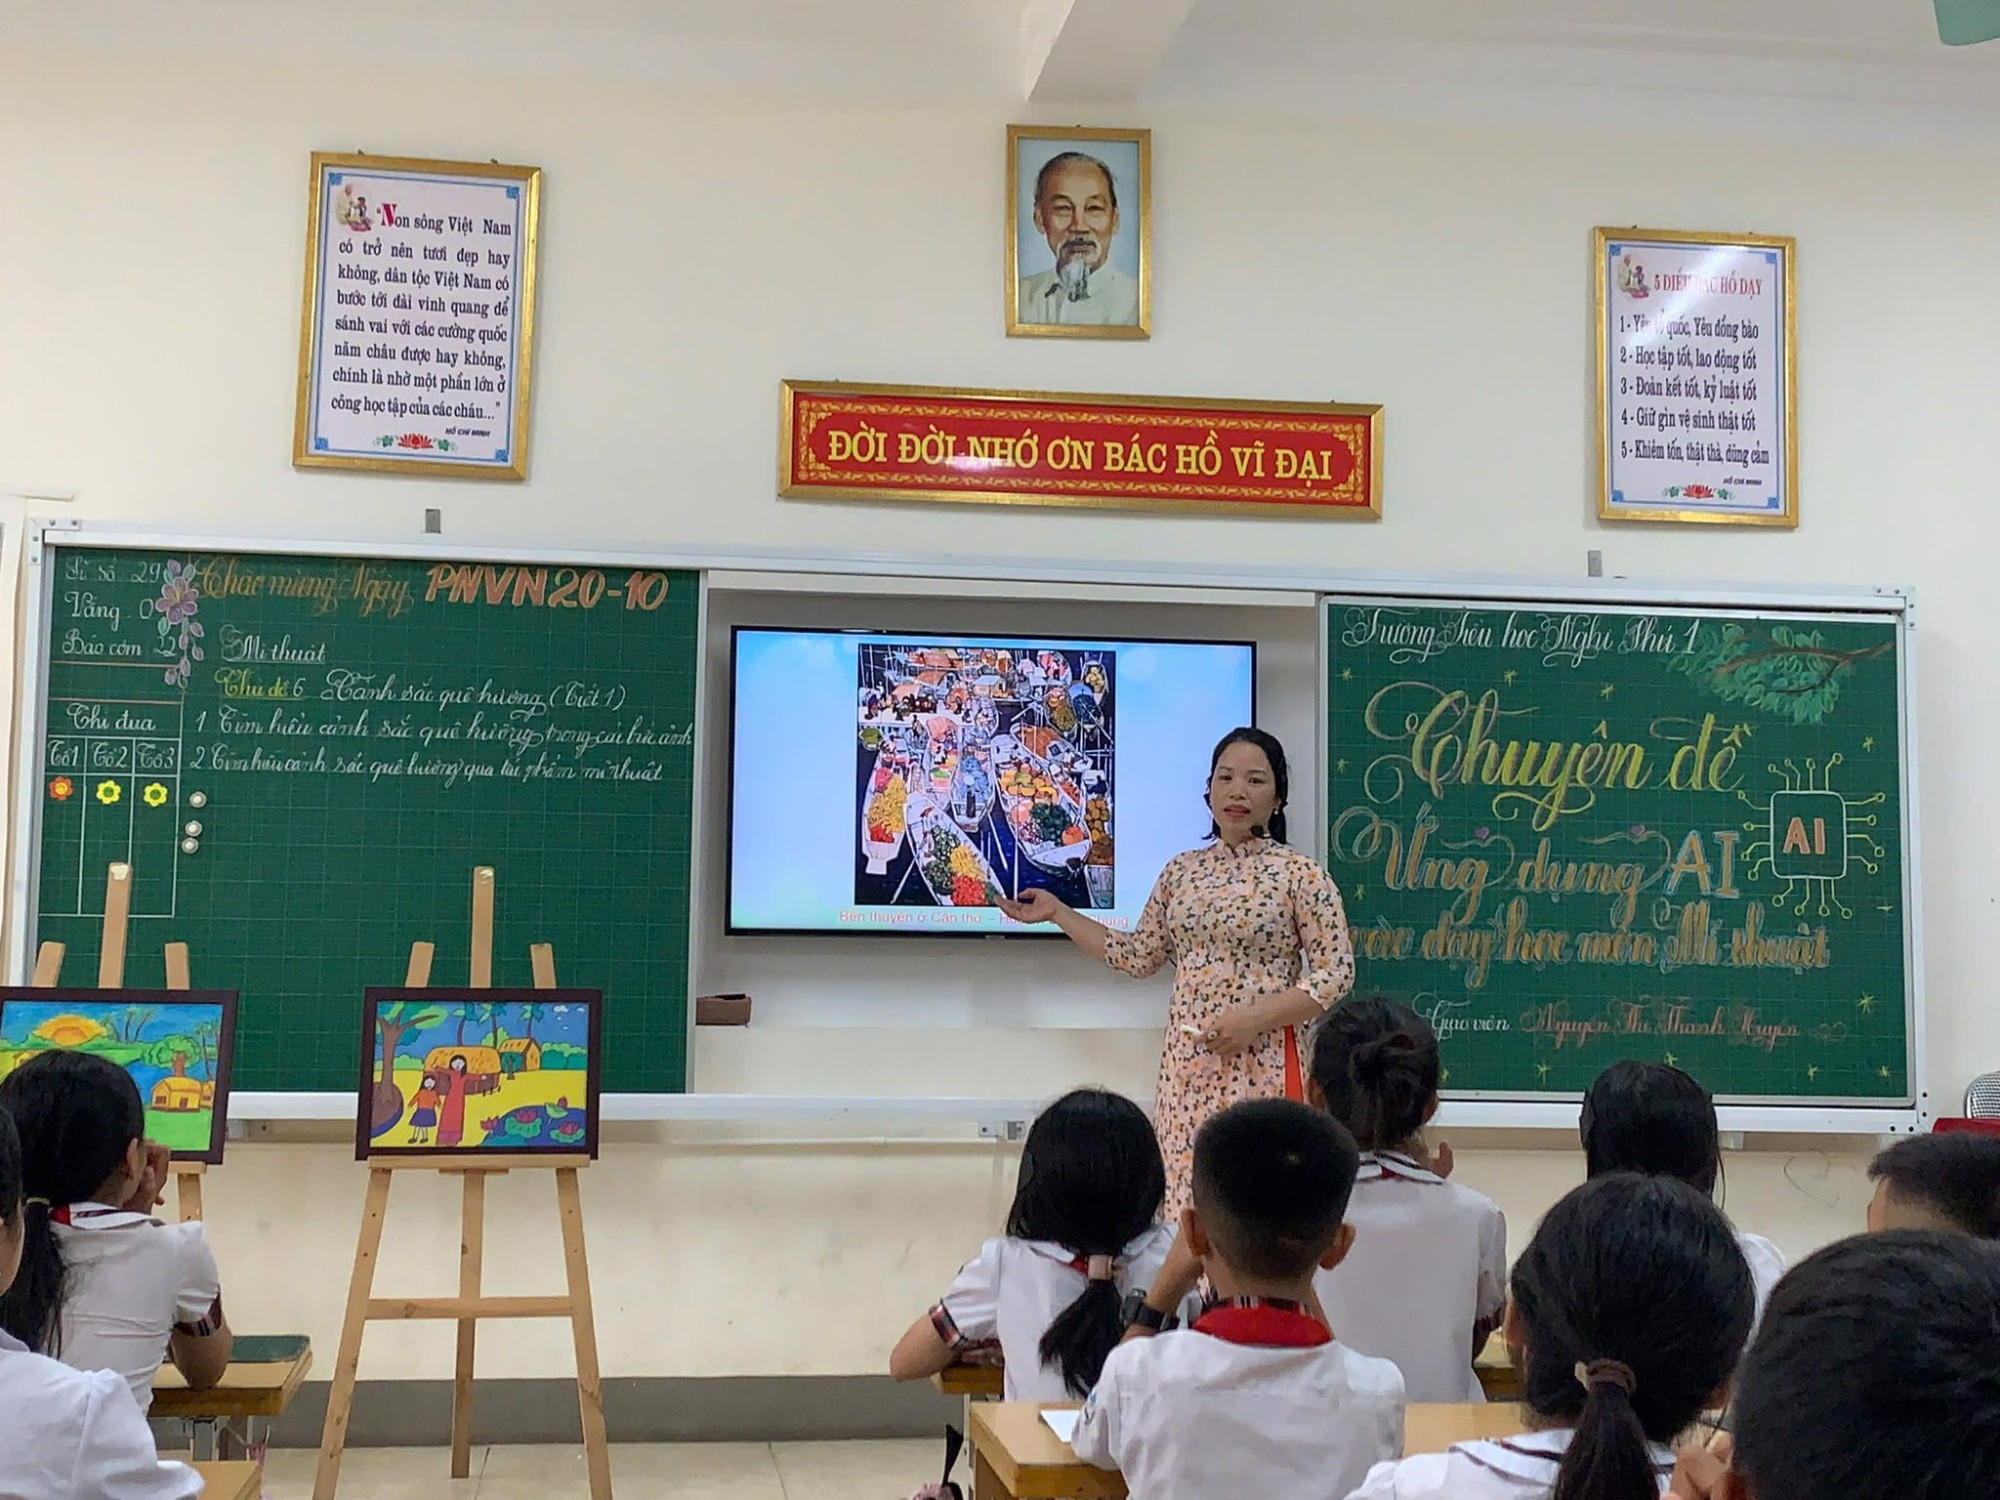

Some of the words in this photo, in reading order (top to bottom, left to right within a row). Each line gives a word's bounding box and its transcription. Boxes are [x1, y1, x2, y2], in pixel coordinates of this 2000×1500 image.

[414, 214, 443, 234] sông
[449, 217, 472, 235] Việt
[484, 219, 510, 235] Nam
[339, 239, 353, 253] có
[363, 238, 381, 255] trở
[391, 242, 412, 258] nên
[424, 246, 446, 261] tươi
[457, 248, 478, 267] đẹp
[488, 250, 510, 269] hay
[339, 264, 381, 285] không,
[385, 267, 407, 283] dân
[413, 269, 430, 285] tộc
[435, 271, 458, 290] Việt
[464, 273, 491, 289] Nam
[496, 276, 509, 290] có
[1655, 275, 1660, 290] 5
[1740, 279, 1762, 299] DẠY
[337, 289, 365, 306] bước
[372, 292, 387, 307] tới
[419, 297, 445, 311] vinh
[451, 302, 489, 318] quang
[494, 296, 509, 316] để
[336, 315, 364, 331] sánh
[369, 319, 387, 333] vai
[392, 320, 410, 335] với
[415, 321, 434, 336] các
[438, 323, 475, 343] cường
[479, 324, 507, 344] quốc
[1694, 317, 1712, 336] Yêu
[1742, 320, 1758, 339] bào
[335, 342, 360, 357] năm
[367, 344, 395, 359] châu
[402, 347, 430, 365] được
[437, 349, 458, 367] hay
[465, 350, 506, 370] không,
[1636, 347, 1654, 369] Học
[1658, 349, 1674, 370] tập
[1696, 348, 1711, 367] lao
[1714, 350, 1739, 373] động
[1743, 348, 1756, 369] tốt
[333, 367, 367, 383] chính
[372, 369, 383, 384] là
[387, 371, 411, 386] nhờ
[414, 373, 436, 391] một
[441, 372, 470, 393] phần
[475, 376, 493, 391] lớn
[498, 375, 505, 392] ở
[1636, 376, 1662, 395] Đoàn
[1666, 375, 1681, 396] kết
[1704, 375, 1716, 403] kỷ
[1720, 380, 1739, 404] luật
[1743, 379, 1756, 400] tốt
[331, 394, 361, 414] công
[364, 396, 385, 415] học
[388, 398, 407, 417] tập
[409, 397, 430, 415] của
[433, 402, 452, 417] các
[1637, 407, 1655, 426] Giữ
[1659, 408, 1675, 432] gìn
[1679, 409, 1690, 432] vệ
[1693, 410, 1715, 428] sinh
[1719, 411, 1738, 434] thật
[1742, 409, 1755, 430] tốt
[828, 421, 887, 462] ĐỜI
[898, 424, 957, 464] ĐỜI
[966, 428, 1039, 468] NHỚ
[1047, 436, 1094, 470] ƠN
[1104, 433, 1167, 474] BÁC
[1175, 429, 1222, 475] HỒ
[1230, 440, 1265, 477] VĨ
[1274, 449, 1332, 487] ĐẠI
[1635, 440, 1664, 459] Khiêm
[1667, 438, 1683, 460] tốn,
[1687, 442, 1704, 465] thật
[1707, 443, 1723, 463] thà,
[1726, 444, 1749, 468] dũng
[1751, 441, 1769, 464] cảm
[131, 561, 161, 583] 29
[1684, 618, 1700, 654] 1
[439, 686, 475, 712] quê
[66, 702, 110, 729] Thi
[115, 710, 156, 731] đua
[319, 708, 369, 737] cảnh
[378, 713, 413, 738] sắc
[419, 720, 462, 747] quê
[1364, 682, 1654, 831] Chuyên
[1650, 713, 1757, 791] đề
[464, 764, 494, 782] qua
[1782, 816, 1825, 855] AI
[1332, 801, 1515, 926] Ứng
[1669, 829, 1741, 898] AI
